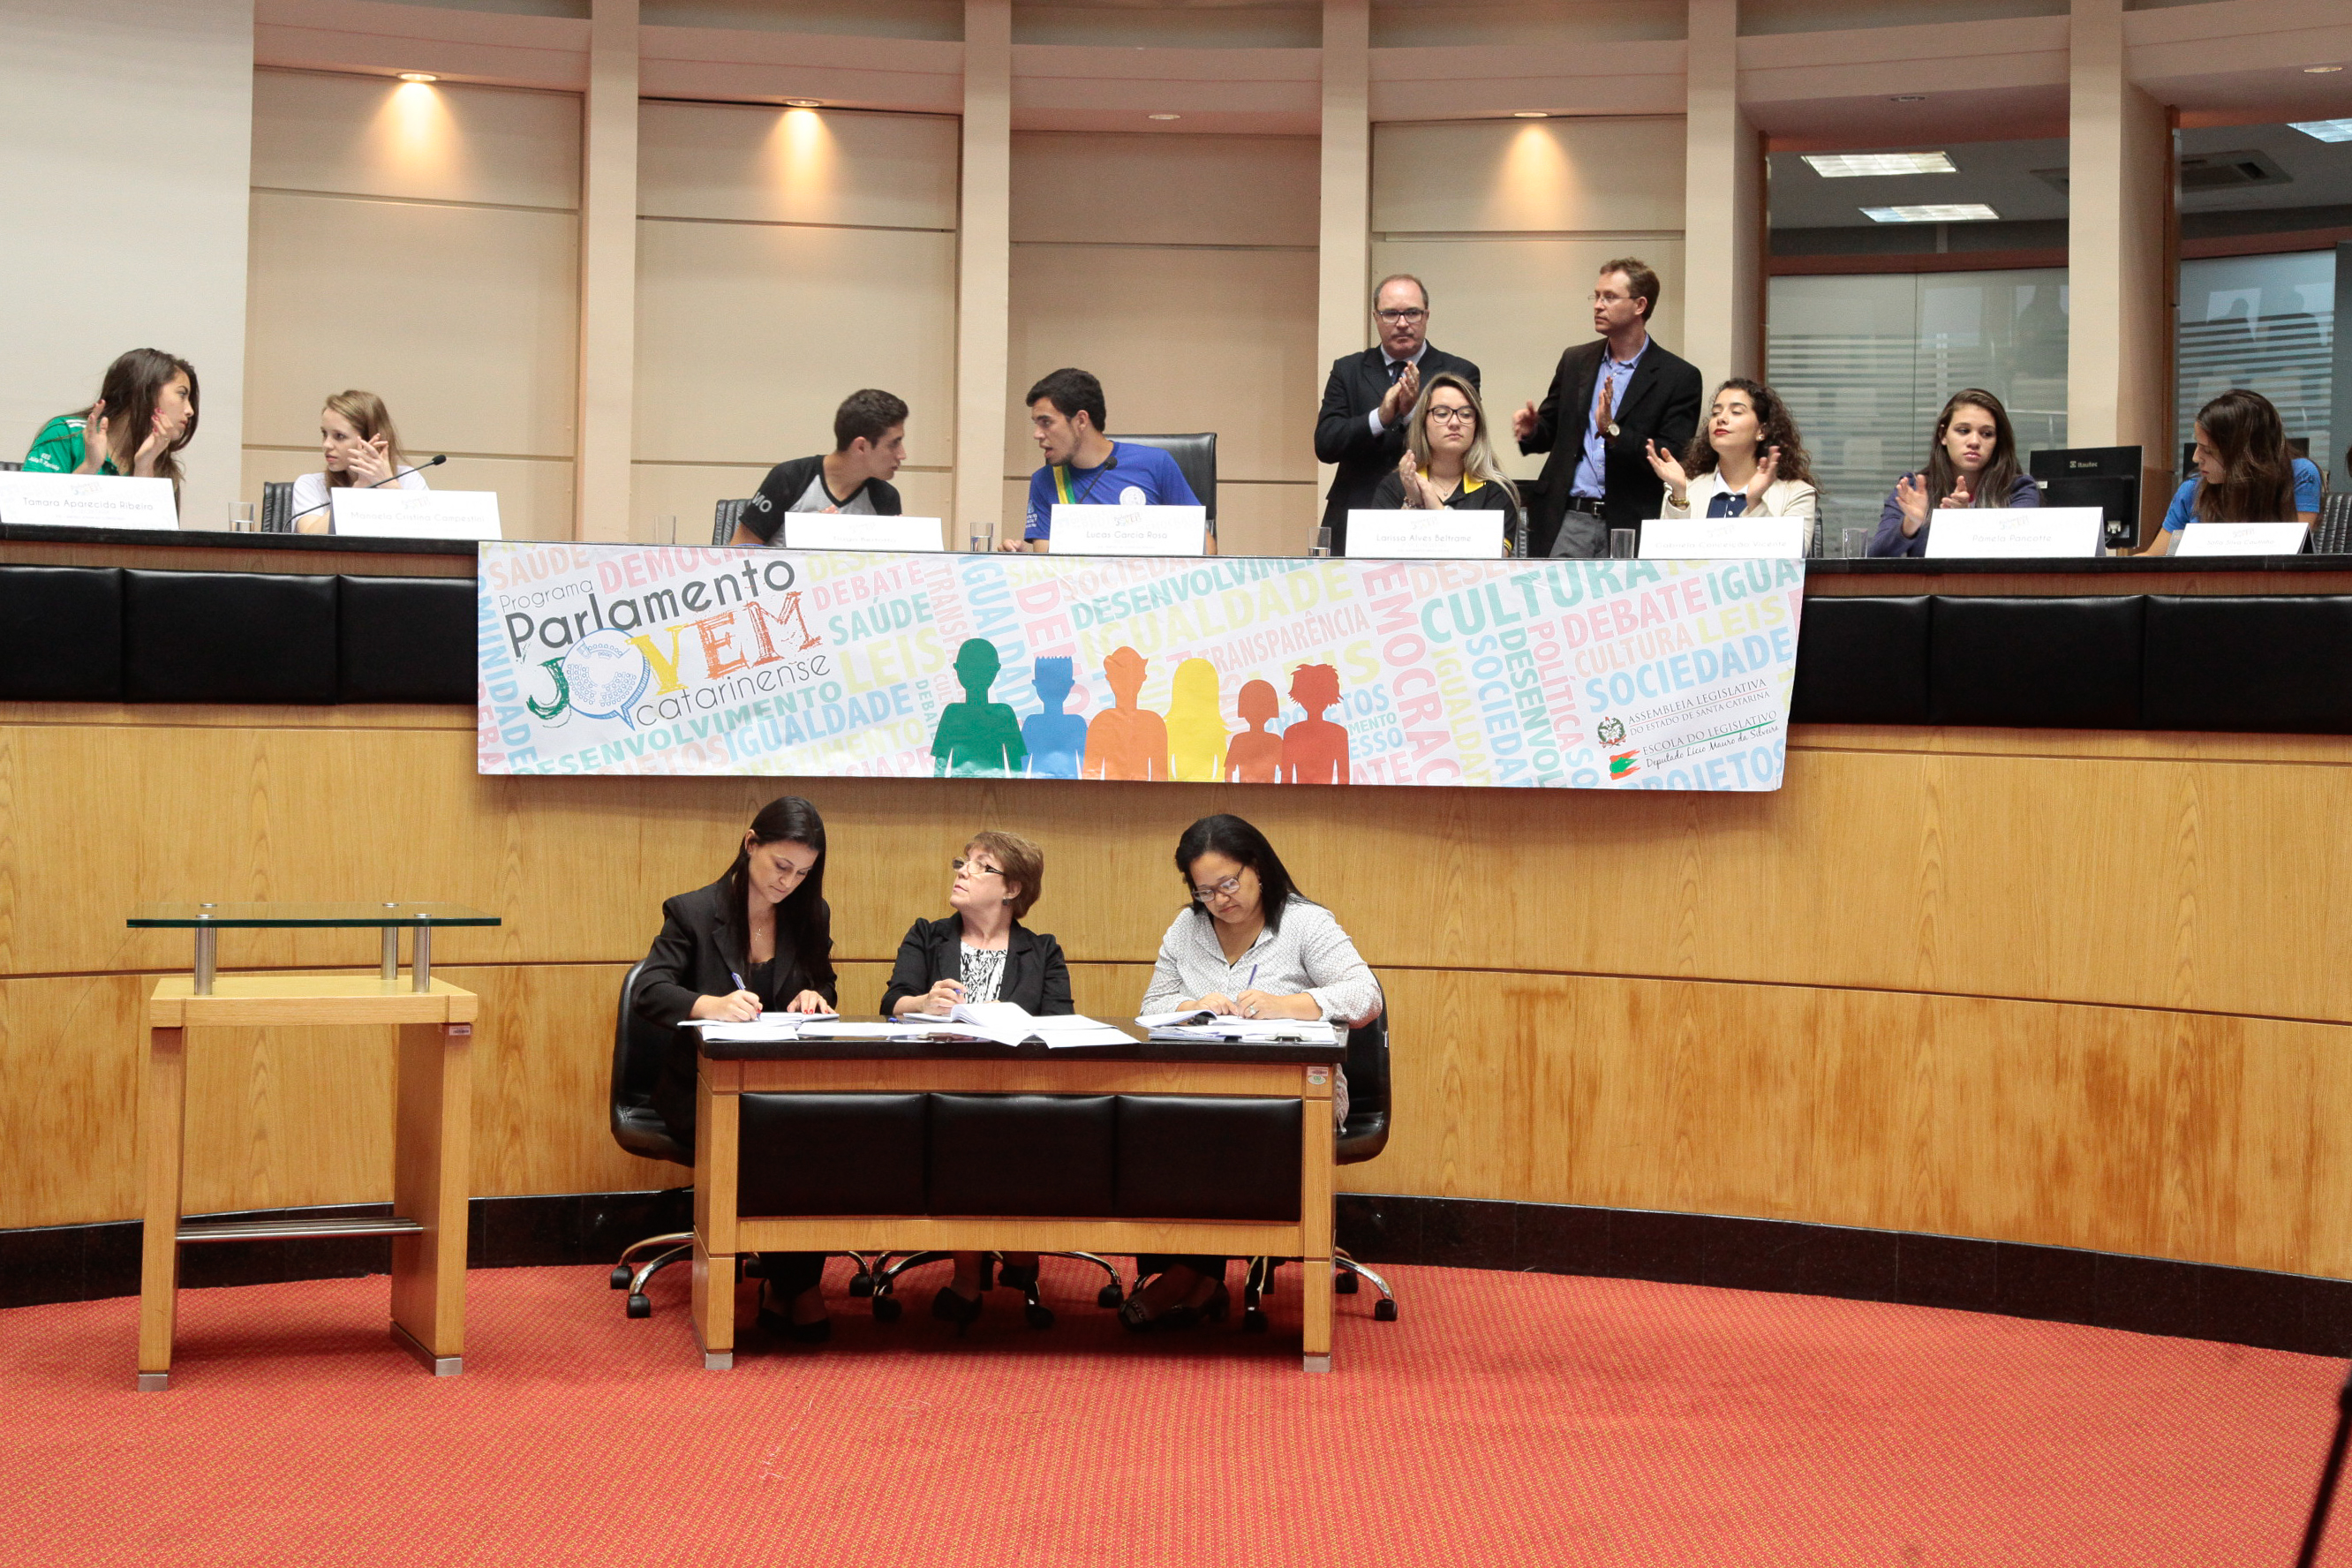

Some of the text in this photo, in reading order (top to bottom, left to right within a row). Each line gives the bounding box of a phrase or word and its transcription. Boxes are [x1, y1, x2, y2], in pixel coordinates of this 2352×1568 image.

[23, 497, 154, 511] Tamara Aparecida Ribeiro
[396, 513, 431, 522] Cristina
[1435, 534, 1472, 543] Beltrame
[499, 579, 593, 614] Programa
[505, 560, 795, 658] Parlamento
[810, 561, 925, 611] DEBATE
[1421, 560, 1661, 644] CULTURA
[1561, 577, 1707, 650] DEBATE
[828, 592, 934, 646] SAÚDE
[1079, 560, 1354, 670] IGUALDADE
[1197, 603, 1371, 675] TRANSPARÊNCIA
[1696, 595, 1786, 645] LEIS
[525, 592, 823, 728] JOVEM
[839, 627, 946, 696] LEIS
[1574, 622, 1695, 678] CULTURA
[1586, 626, 1793, 713] SOCIEDADE
[637, 654, 831, 727] catarinense
[1628, 698, 1694, 725] ASSEMBLEIA
[1696, 678, 1767, 705] LEGISLATIVA
[1630, 691, 1770, 736] DO ESTADO DE SANTA CATARINA
[724, 682, 914, 762] IGUALDADE
[1642, 710, 1777, 755] ESCOLA DO LEGISLATIVO
[1646, 724, 1779, 770] Deputado Lício Mauro da Silveira
